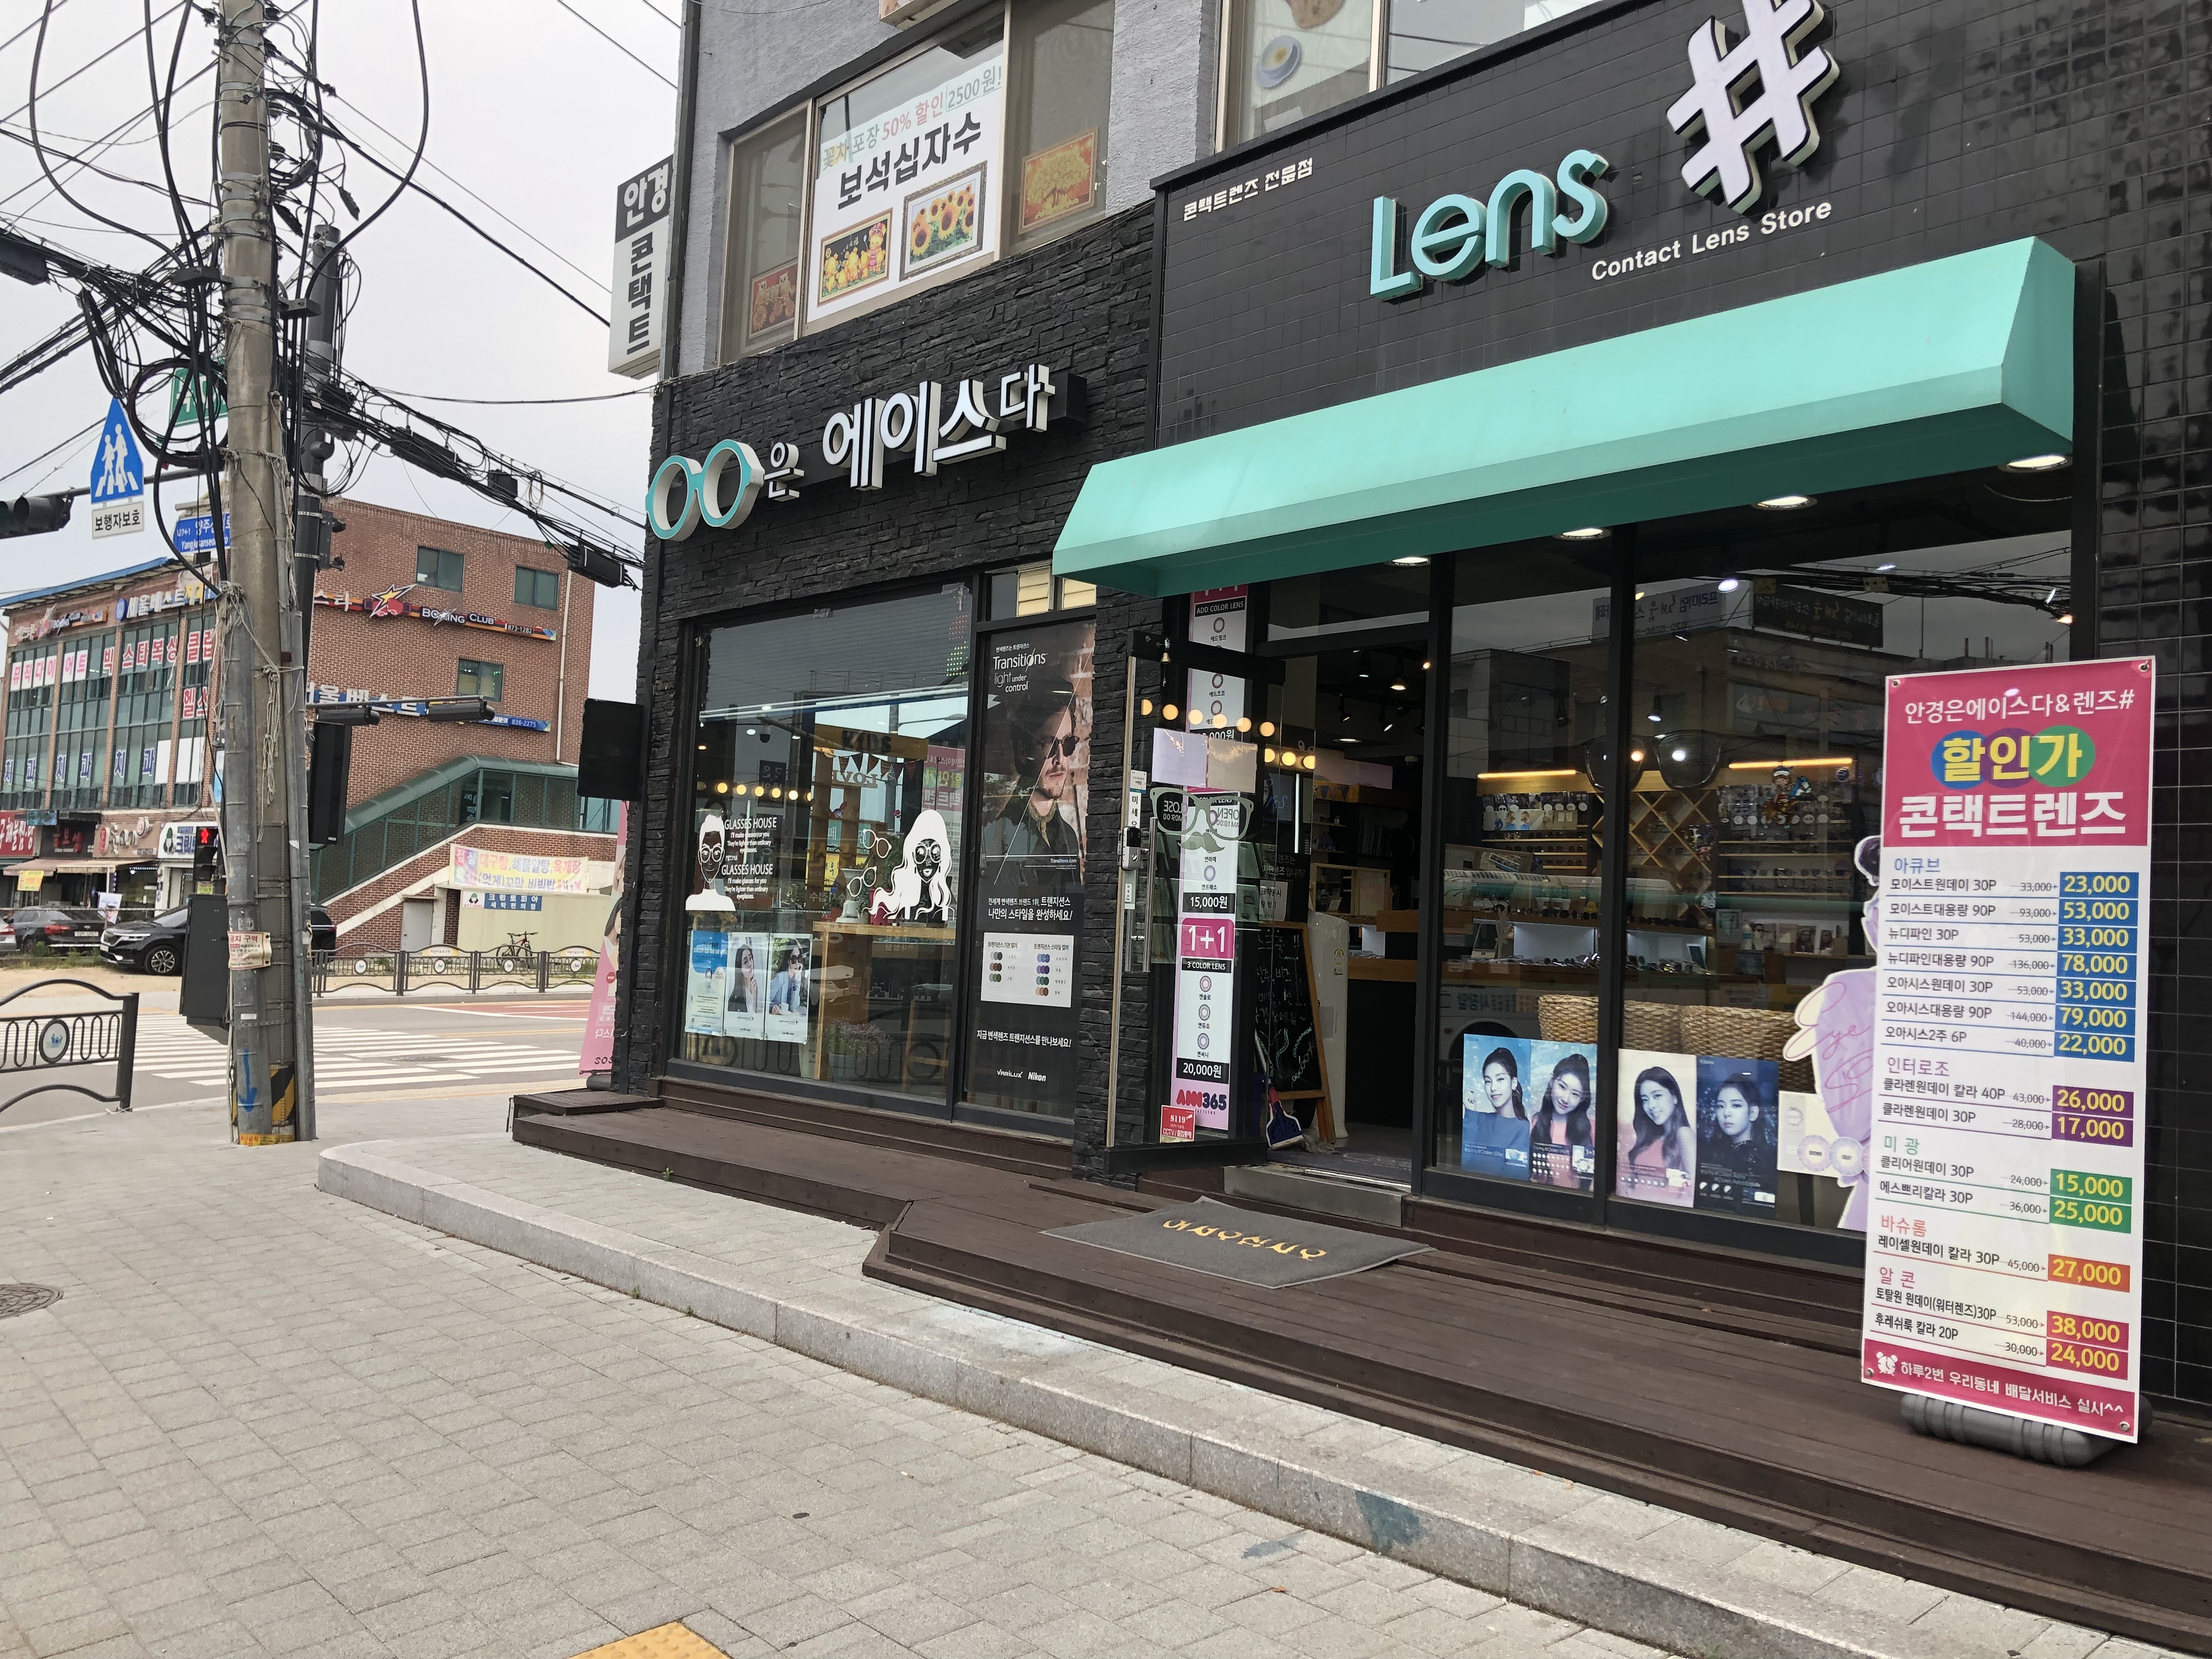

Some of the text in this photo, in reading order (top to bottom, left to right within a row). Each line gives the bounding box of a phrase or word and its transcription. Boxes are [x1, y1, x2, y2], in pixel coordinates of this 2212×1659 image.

[853, 122, 880, 154] 포장
[882, 112, 911, 142] 50%
[915, 91, 944, 124] 할인
[838, 111, 982, 211] 보석십자수
[622, 162, 669, 224] 안경
[1182, 156, 1314, 222] 콘택트렌즈 전문점
[1368, 149, 1612, 302] Lens
[1591, 200, 1833, 283] Contact Lens Store
[627, 230, 654, 356] 콘택트
[94, 509, 141, 532] 보행자보호
[1196, 601, 1244, 615] ADD COLOR LENS
[469, 613, 494, 625] CLUB
[507, 624, 533, 634] 873-1282
[992, 650, 1047, 672] Transitions
[994, 672, 1027, 688] light under
[1005, 681, 1029, 692] control
[1905, 689, 2135, 724] 안경은에이스다&렌즈#
[1943, 732, 2083, 782] 할인가
[724, 817, 777, 830] GLASSES HOUSE
[1899, 791, 2127, 838] 콘택트렌즈
[721, 864, 774, 876] GLASSES HOUSE
[1894, 857, 1941, 874] 아큐브
[1891, 878, 1969, 892] 모이스트원데이
[1973, 879, 1997, 891] 30P
[2064, 874, 2130, 895] 23,000
[1190, 895, 1228, 909] 15,000원
[1889, 902, 1968, 917] 모이스트대용량
[1972, 905, 1996, 917] 90P
[2063, 901, 2130, 922] 53,000
[988, 908, 1073, 921] 나만의 스타일을 완성하세요!
[1188, 926, 1225, 953] 1+1
[1888, 927, 1933, 941] 뉴디파인
[1936, 929, 1959, 941] 30P
[2062, 927, 2129, 949] 33,000
[1887, 951, 1967, 968] 뉴디파인대용량
[1970, 955, 1994, 968] 90P
[2061, 953, 2128, 975] 78,000
[1887, 977, 1966, 993] 오아시스원데이
[1969, 980, 1993, 994] 30P
[2060, 979, 2127, 1002] 33,000
[1886, 1001, 1965, 1018] 오아시스대용량
[1968, 1006, 1993, 1019] 90P
[2059, 1006, 2126, 1029] 79,000
[977, 1029, 988, 1040] 지금
[1041, 1035, 1072, 1048] 만나보세요!
[1885, 1026, 1948, 1042] 오아시스2주
[1951, 1030, 1967, 1043] 6P
[2058, 1033, 2126, 1056] 22,000
[1028, 1071, 1047, 1082] Nikon
[1183, 1062, 1222, 1079] 20,000원
[1887, 1057, 1950, 1076] 인터로조
[1883, 1077, 1949, 1097] 클라렌원데이
[1954, 1084, 1978, 1098] 칼라
[1981, 1086, 2006, 1099] 40P
[2057, 1088, 2125, 1112] 26,000
[1882, 1102, 1949, 1121] 클라렌원데이
[1952, 1110, 1976, 1124] 30P
[2057, 1116, 2125, 1140] 17,000
[1884, 1135, 1920, 1155] 미 광
[1881, 1155, 1946, 1176] 클리어원데이
[1950, 1164, 1974, 1178] 30P
[2055, 1173, 2123, 1198] 15,000
[1880, 1181, 1946, 1202] 에스쁘리칼라
[1949, 1190, 1973, 1204] 30P
[2054, 1200, 2123, 1226] 25,000
[1881, 1215, 1927, 1238] 바슈롬
[1878, 1234, 1944, 1259] 레이셀원데이
[1948, 1245, 1972, 1263] 칼라
[1976, 1251, 2000, 1266] 30P
[2052, 1259, 2121, 1286] 27,000
[1879, 1266, 1915, 1289] 알 콘
[1876, 1286, 1903, 1304] 토탈원
[2051, 1315, 2120, 1343] 38,000
[1875, 1312, 1914, 1333] 후레쉬룩
[1916, 1319, 1936, 1335] 칼라
[1939, 1326, 1959, 1340] 20P
[2051, 1342, 2119, 1372] 24,000
[1900, 1361, 1944, 1383] 하루2번
[1949, 1372, 2000, 1395] 우리동네
[2005, 1382, 2072, 1409] 배달서비스
